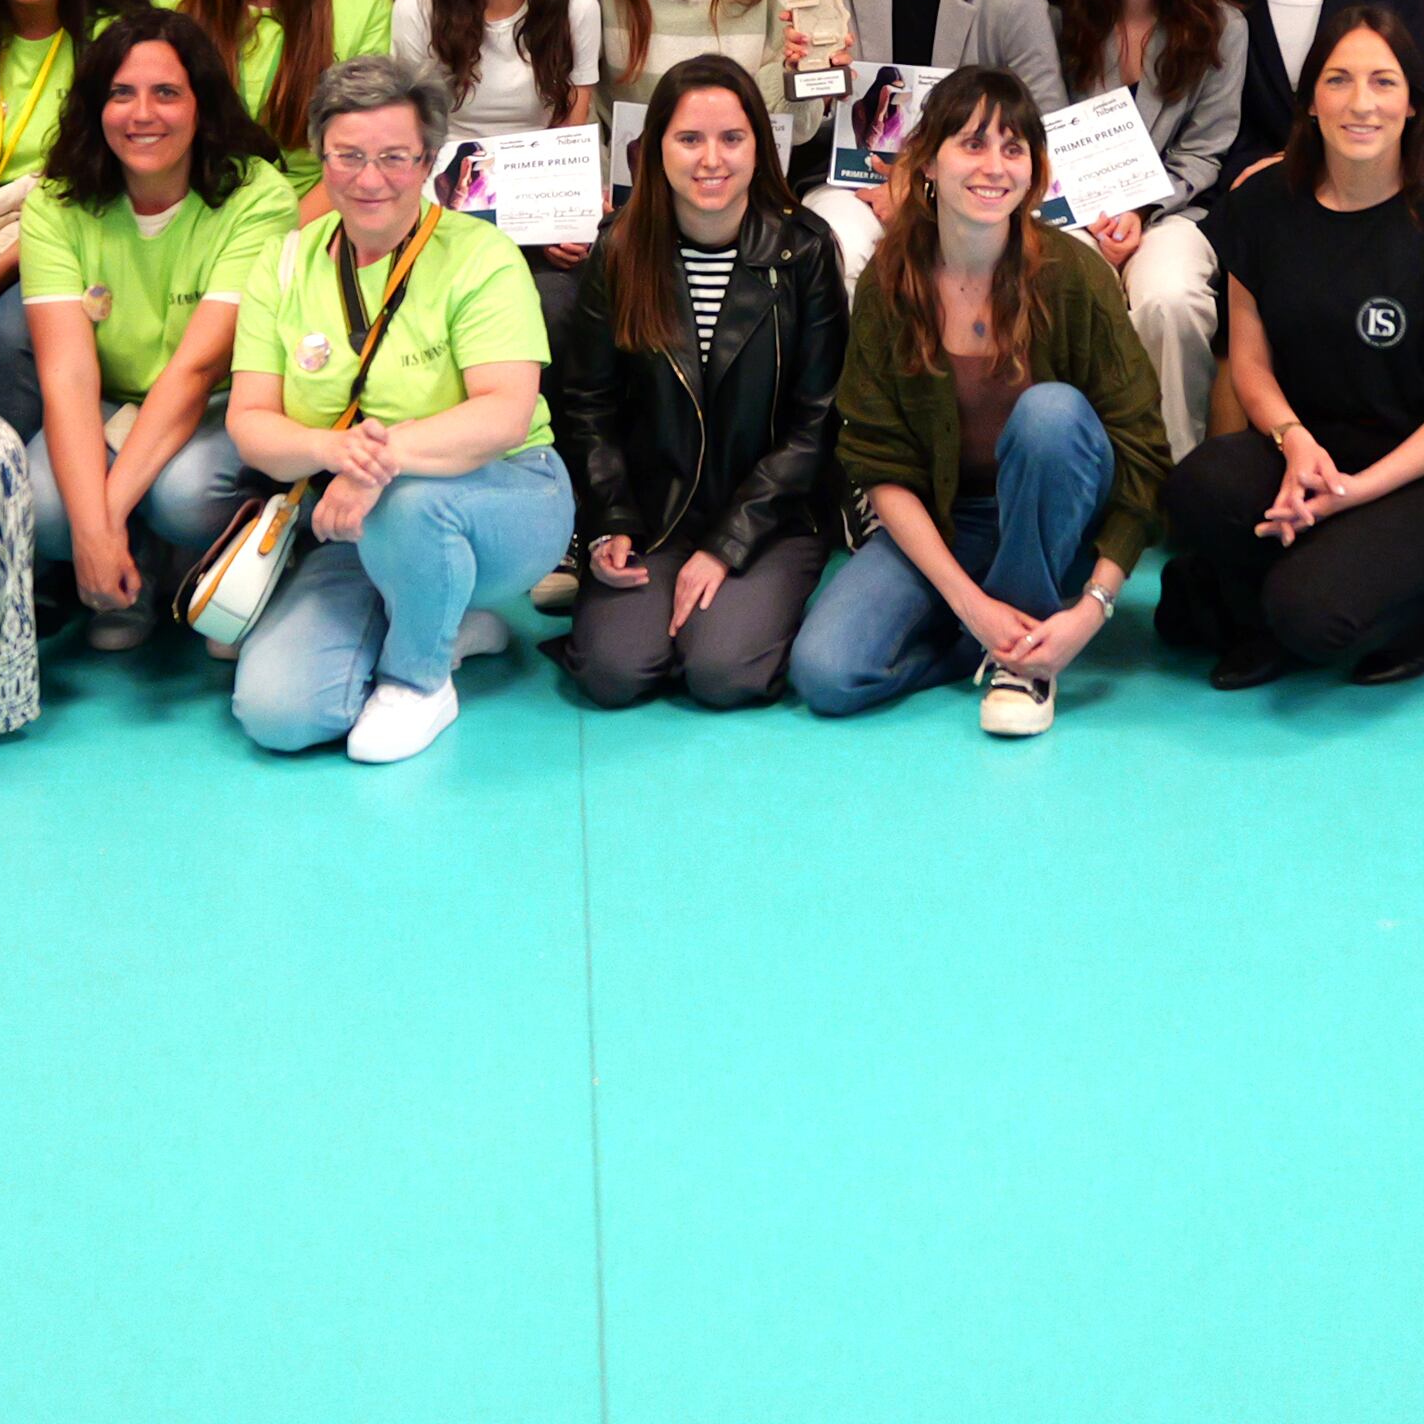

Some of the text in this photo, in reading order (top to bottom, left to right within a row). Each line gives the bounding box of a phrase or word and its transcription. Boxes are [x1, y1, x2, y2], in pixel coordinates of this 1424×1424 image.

[1053, 121, 1135, 155] PRIMER PREMIO
[503, 155, 591, 171] PRIMER PREMIO
[840, 169, 869, 178] PRIMER
[1367, 307, 1396, 336] IS
